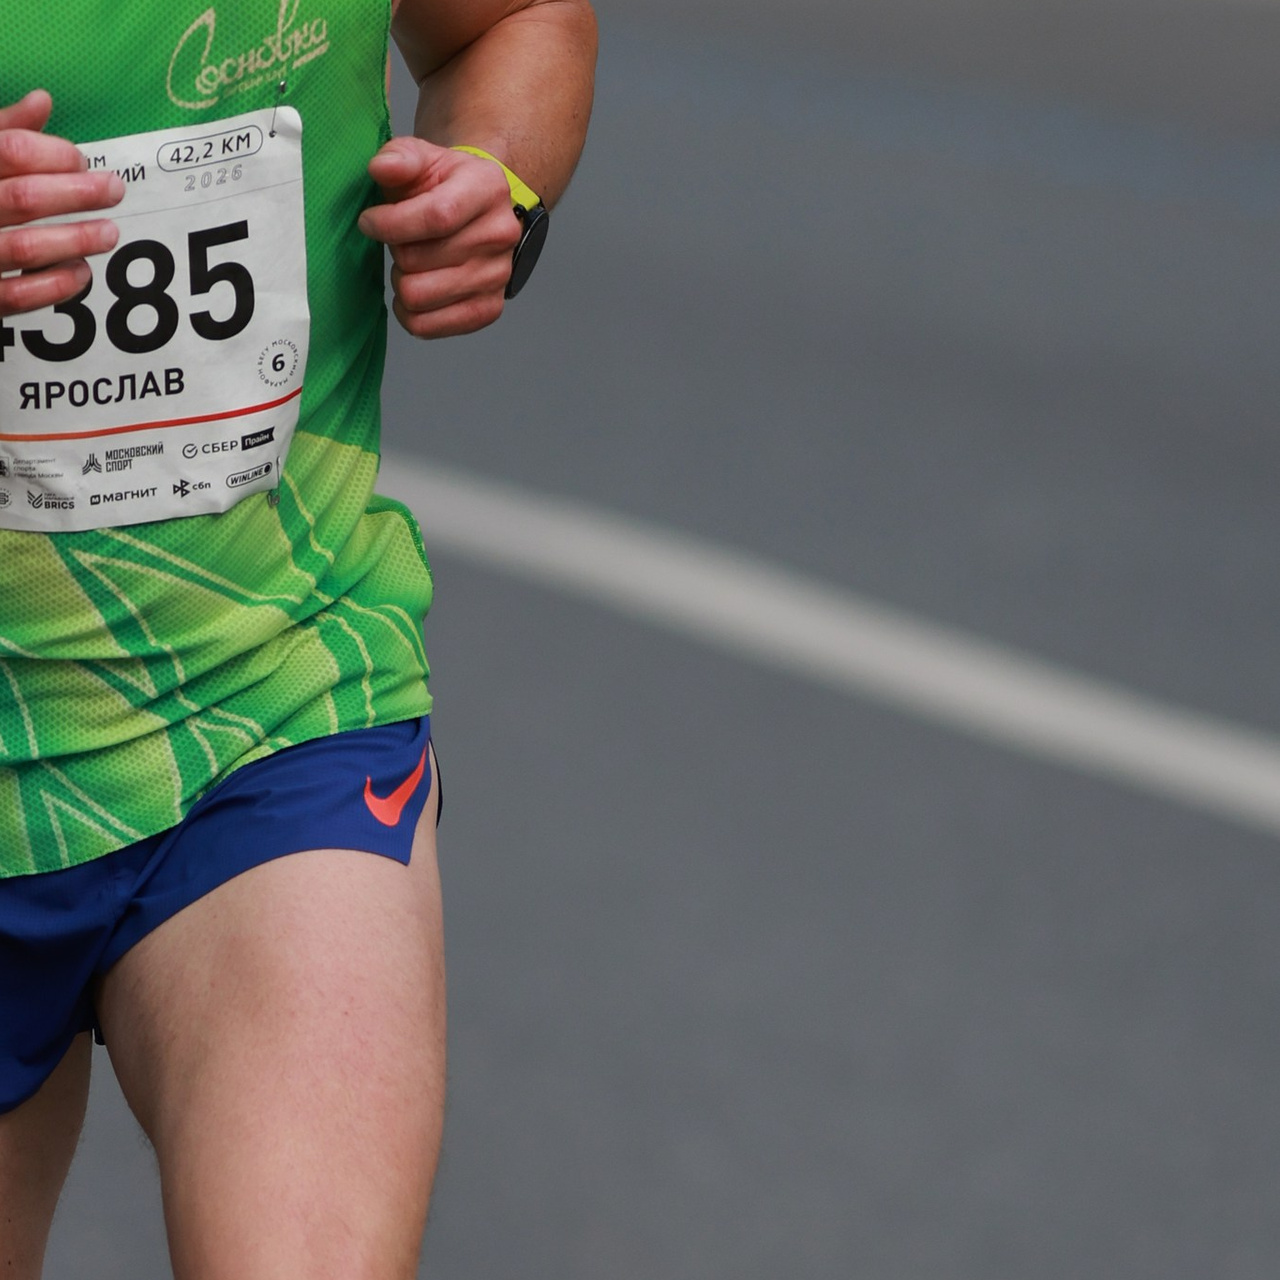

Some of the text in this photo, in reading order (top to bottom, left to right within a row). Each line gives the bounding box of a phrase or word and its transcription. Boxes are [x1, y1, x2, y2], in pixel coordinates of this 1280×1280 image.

[169, 132, 251, 165] 42,2 КМ
[184, 164, 243, 192] 2026
[272, 353, 285, 372] 6
[20, 368, 185, 410] ЯРОСЛАВ
[201, 440, 239, 454] СБЕР
[244, 432, 270, 447] Прайм
[105, 441, 164, 460] МОСКОВСКИЙ
[105, 459, 133, 473] СПОРТ
[230, 467, 263, 485] WINLINE
[192, 482, 211, 491] сбп
[44, 501, 75, 510] BRICS
